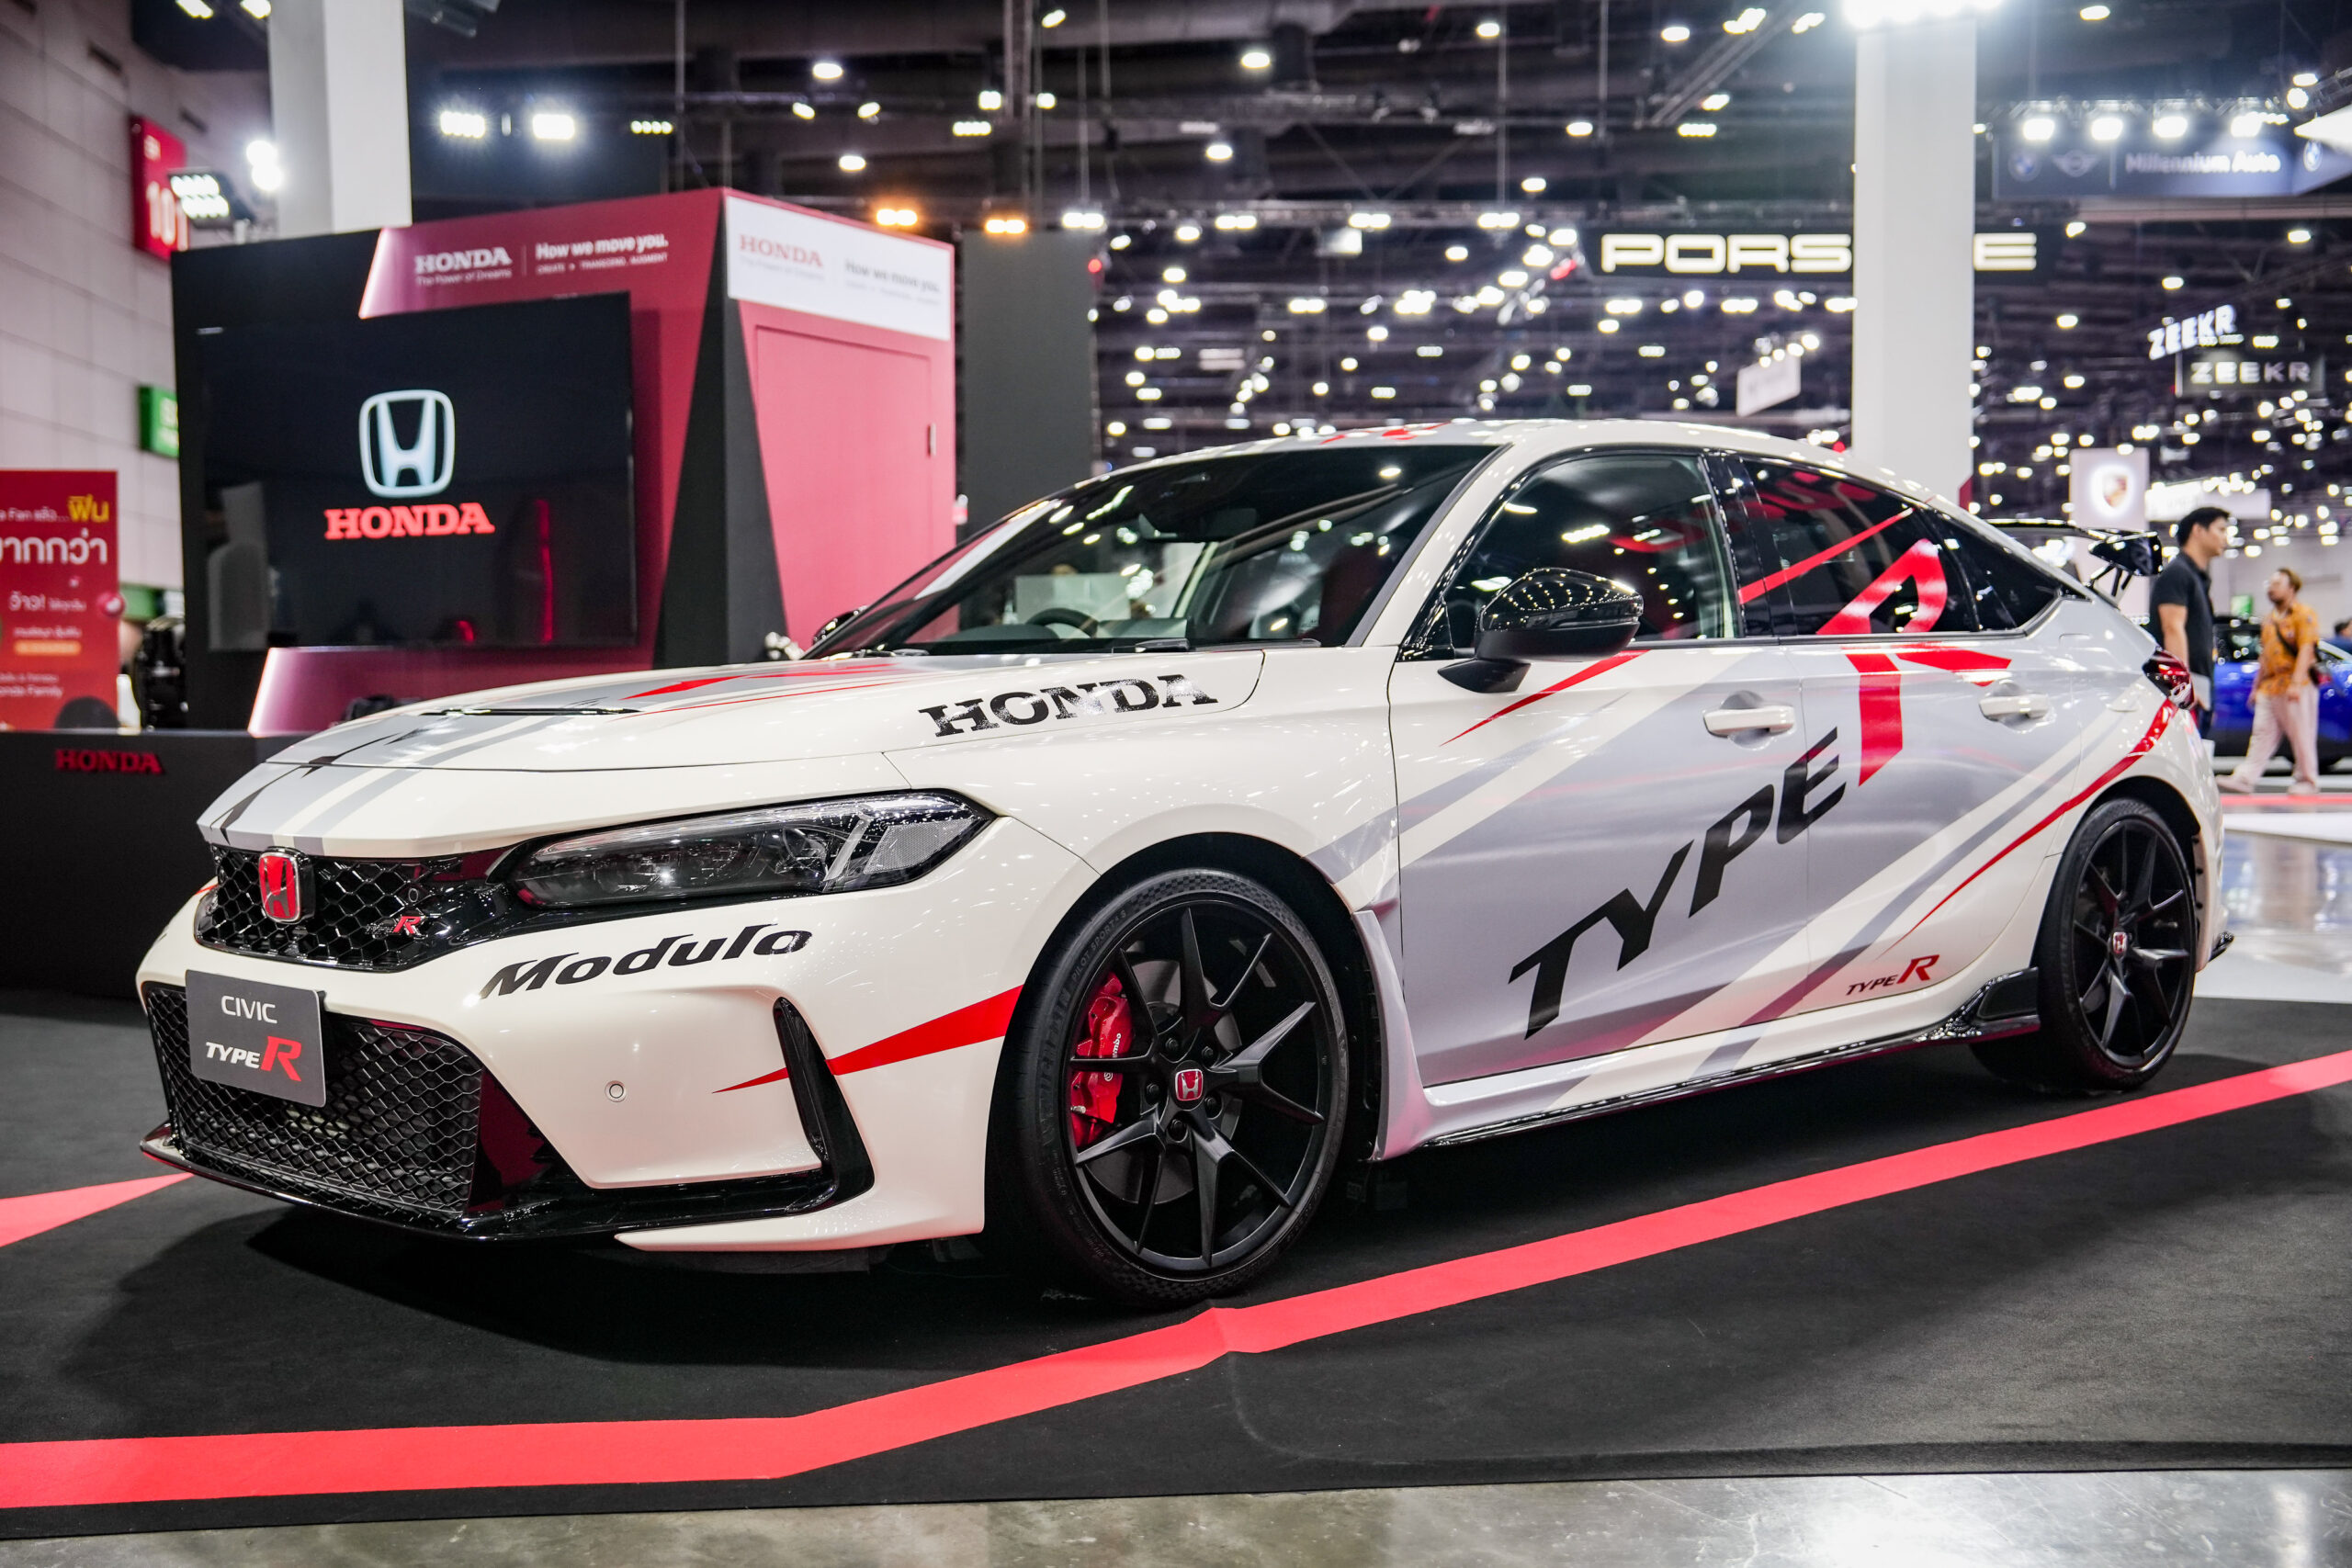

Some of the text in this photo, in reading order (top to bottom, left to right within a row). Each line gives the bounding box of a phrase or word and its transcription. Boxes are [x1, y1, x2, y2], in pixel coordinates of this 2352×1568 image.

[2125, 150, 2281, 174] Millennium Auto
[414, 247, 513, 275] HONDA
[536, 233, 669, 260] How we move you.
[739, 234, 824, 268] HONDA
[1600, 232, 2038, 274] PORSE
[2147, 304, 2237, 360] ZEEKR
[2190, 361, 2312, 384] ZEEKR
[323, 502, 496, 540] HONDA
[918, 673, 1219, 738] HONDA
[56, 749, 163, 773] HONDA
[1508, 727, 1847, 1041] TYPE
[479, 923, 812, 999] Modulo
[1846, 954, 1940, 996] TYPE R
[220, 995, 278, 1024] CIVIC
[206, 1035, 302, 1082] TYPE R
